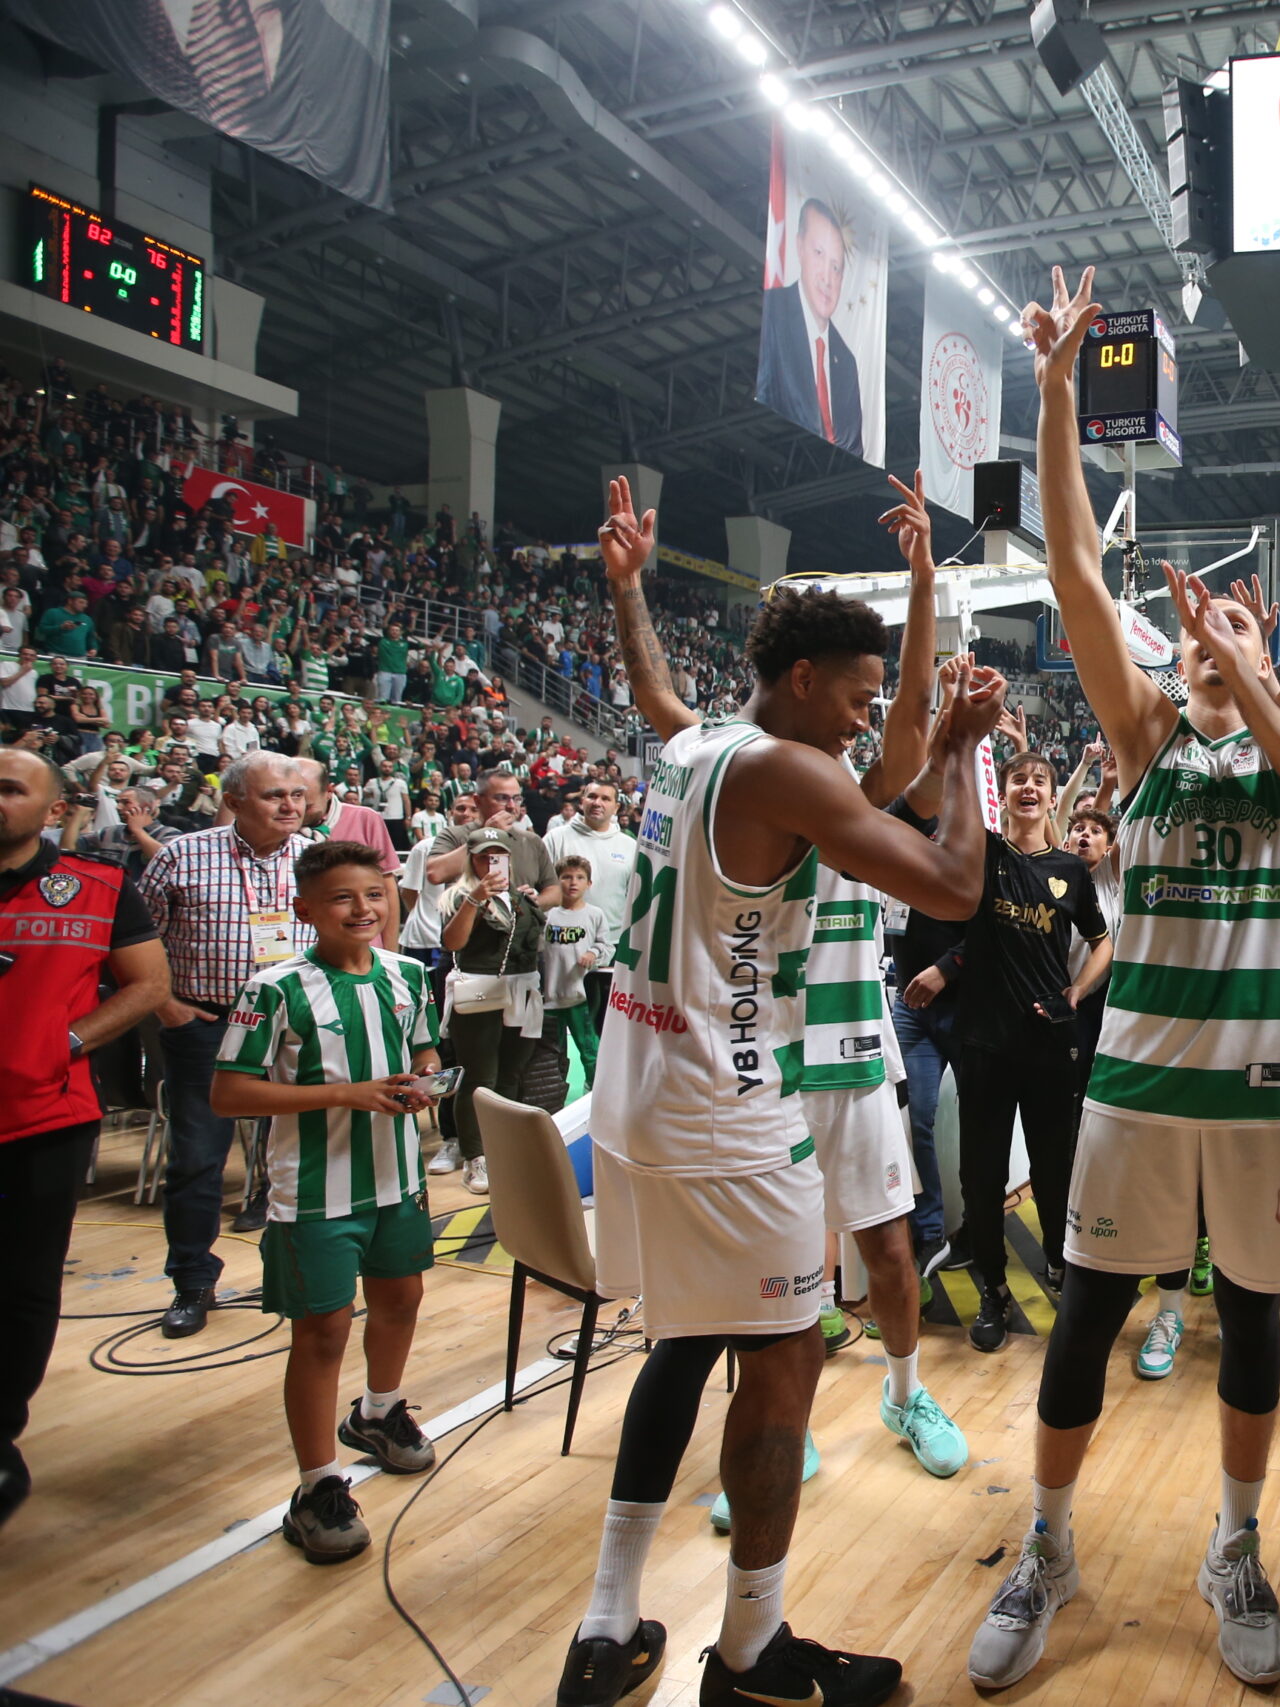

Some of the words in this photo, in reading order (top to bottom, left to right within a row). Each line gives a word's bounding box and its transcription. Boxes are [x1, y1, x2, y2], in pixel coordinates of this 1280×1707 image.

[87, 223, 112, 246] 82
[147, 247, 167, 270] 76
[1175, 780, 1203, 792] upon
[1190, 822, 1242, 870] 30
[614, 851, 678, 984] 21
[733, 1048, 764, 1097] YB
[1090, 1225, 1118, 1239] upon
